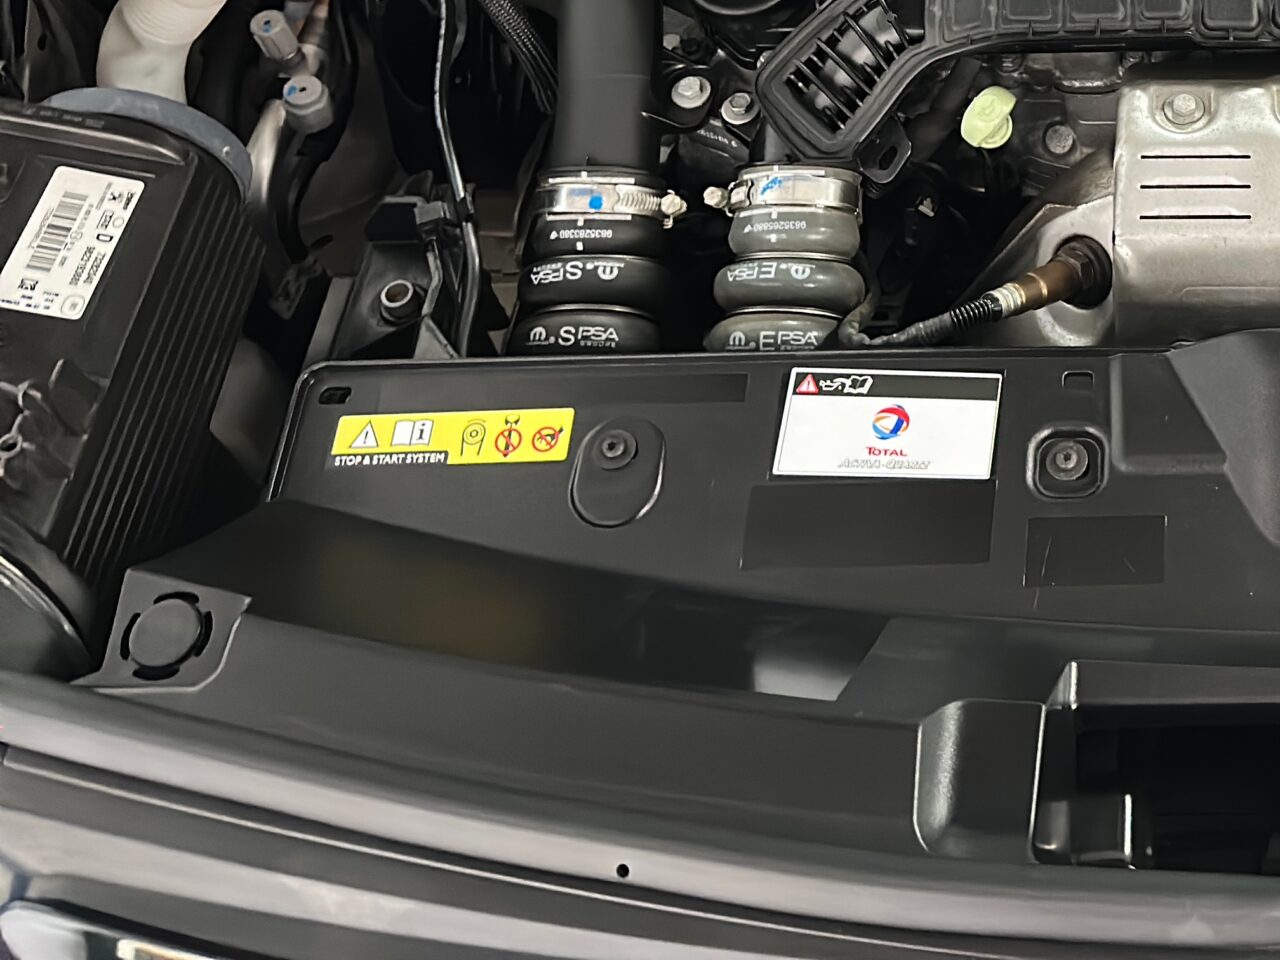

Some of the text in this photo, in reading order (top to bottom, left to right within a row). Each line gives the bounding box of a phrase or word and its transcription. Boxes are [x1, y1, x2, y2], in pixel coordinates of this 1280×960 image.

[530, 267, 564, 285] PSA
[727, 266, 759, 282] PSA
[558, 326, 619, 346] S PSA
[760, 331, 819, 351] E PSA
[334, 452, 446, 466] STOP & START SYSTEM
[866, 446, 908, 457] TOTAL
